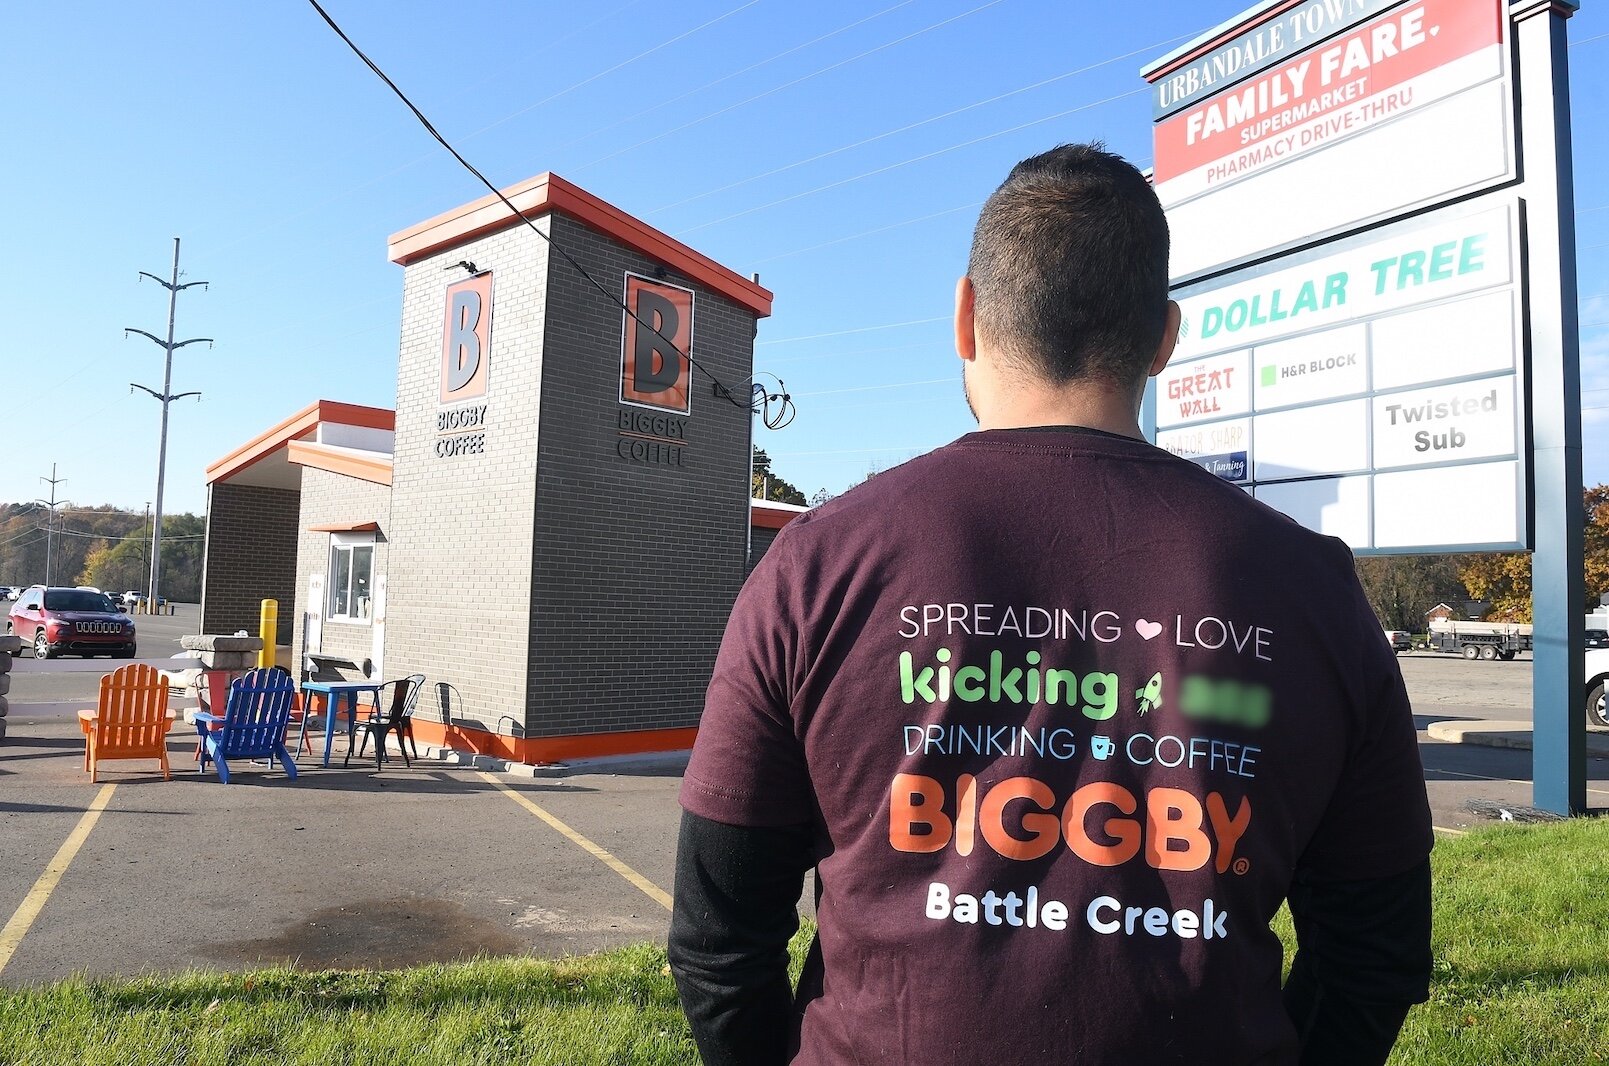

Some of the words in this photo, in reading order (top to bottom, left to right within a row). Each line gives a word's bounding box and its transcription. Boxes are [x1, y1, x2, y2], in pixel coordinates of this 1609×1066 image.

[1158, 23, 1284, 109] URBANDALE
[1186, 60, 1312, 146] FAMILY
[1240, 77, 1367, 145] SUPERMARKET
[1207, 135, 1295, 184] PHARMACY
[1301, 86, 1413, 146] DRIVE-THRU
[1201, 271, 1349, 340] DOLLAR
[1370, 233, 1489, 296] TREE
[447, 290, 482, 393] B
[633, 288, 681, 394] B
[1168, 367, 1235, 400] GREAT
[1194, 364, 1206, 373] THE
[1281, 363, 1307, 379] H&R
[1309, 352, 1357, 374] BLOCK
[437, 405, 487, 431] BIGGBY
[618, 409, 688, 440] BIGGBY
[1179, 397, 1221, 418] WALL
[1385, 389, 1498, 426] Twisted
[435, 433, 486, 458] COFFEE
[617, 438, 688, 467] COFFEE
[1170, 431, 1203, 456] RAZOR
[1211, 426, 1243, 452] SHARP
[1414, 427, 1466, 453] Sub
[1212, 460, 1246, 477] Tanning
[898, 603, 1122, 643] SPREADING
[1176, 614, 1274, 661] LOVE
[899, 647, 1119, 721] kicking
[903, 725, 1076, 760] DRINKING
[1125, 732, 1262, 778] COFFEE
[925, 881, 1069, 931] Battle
[1086, 896, 1228, 940] Creek
